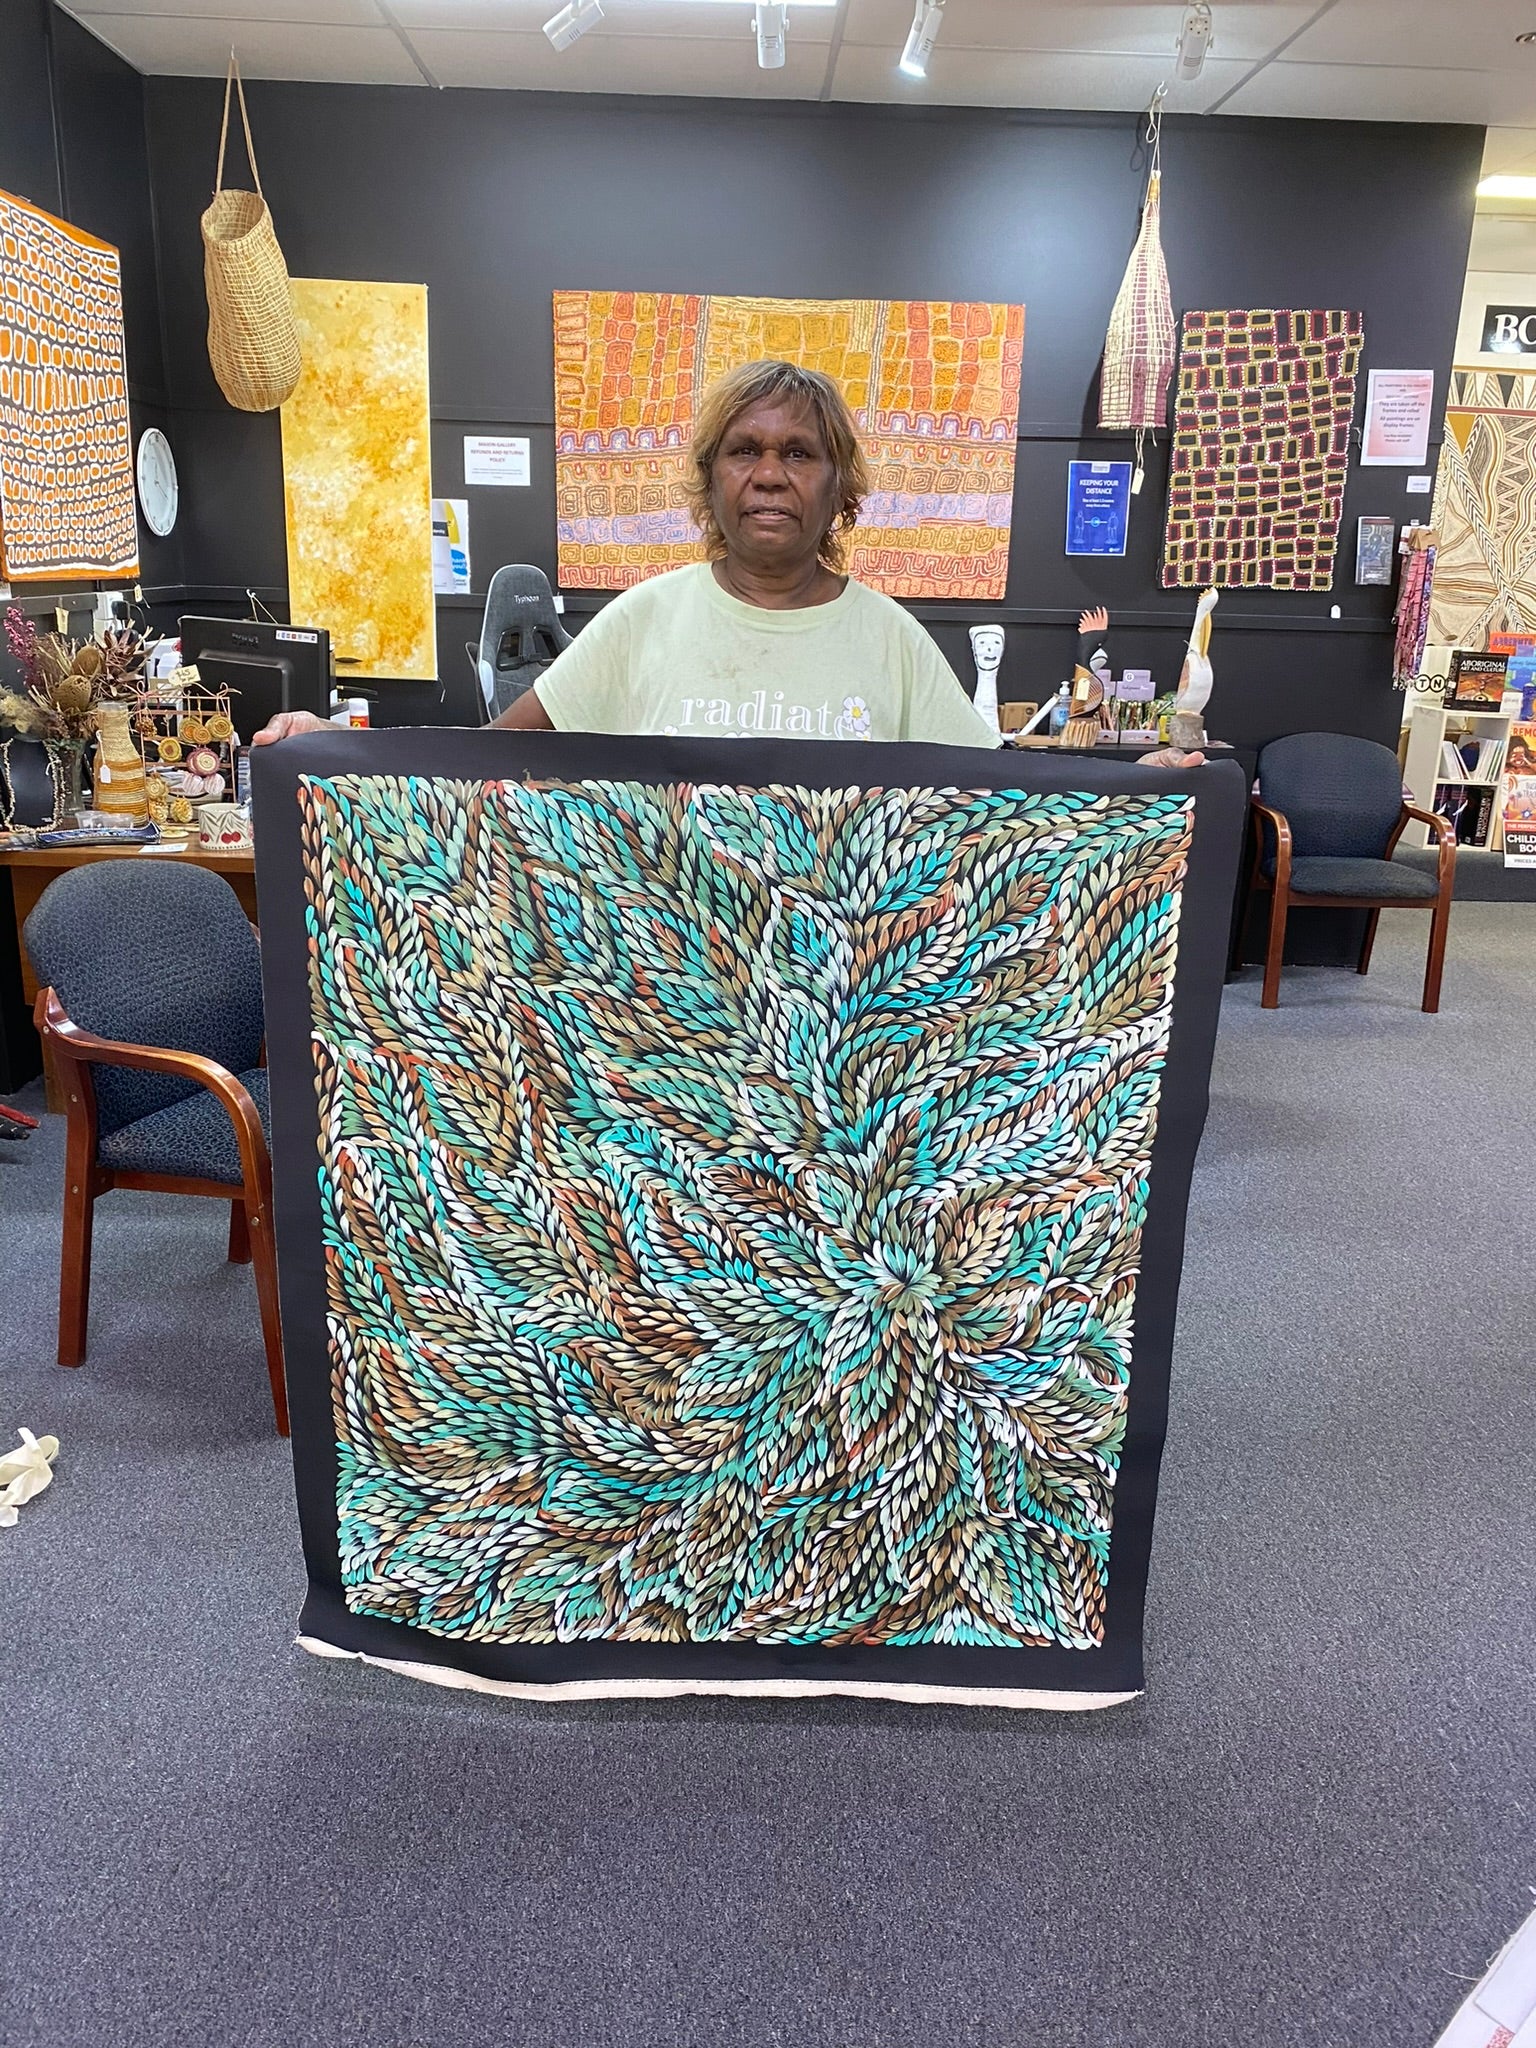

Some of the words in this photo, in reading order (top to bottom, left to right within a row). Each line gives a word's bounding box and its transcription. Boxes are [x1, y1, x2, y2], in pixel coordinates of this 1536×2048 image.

[1460, 660, 1506, 668] ABORIGINAL
[1506, 833, 1536, 844] CHILD
[1519, 843, 1536, 853] BO
